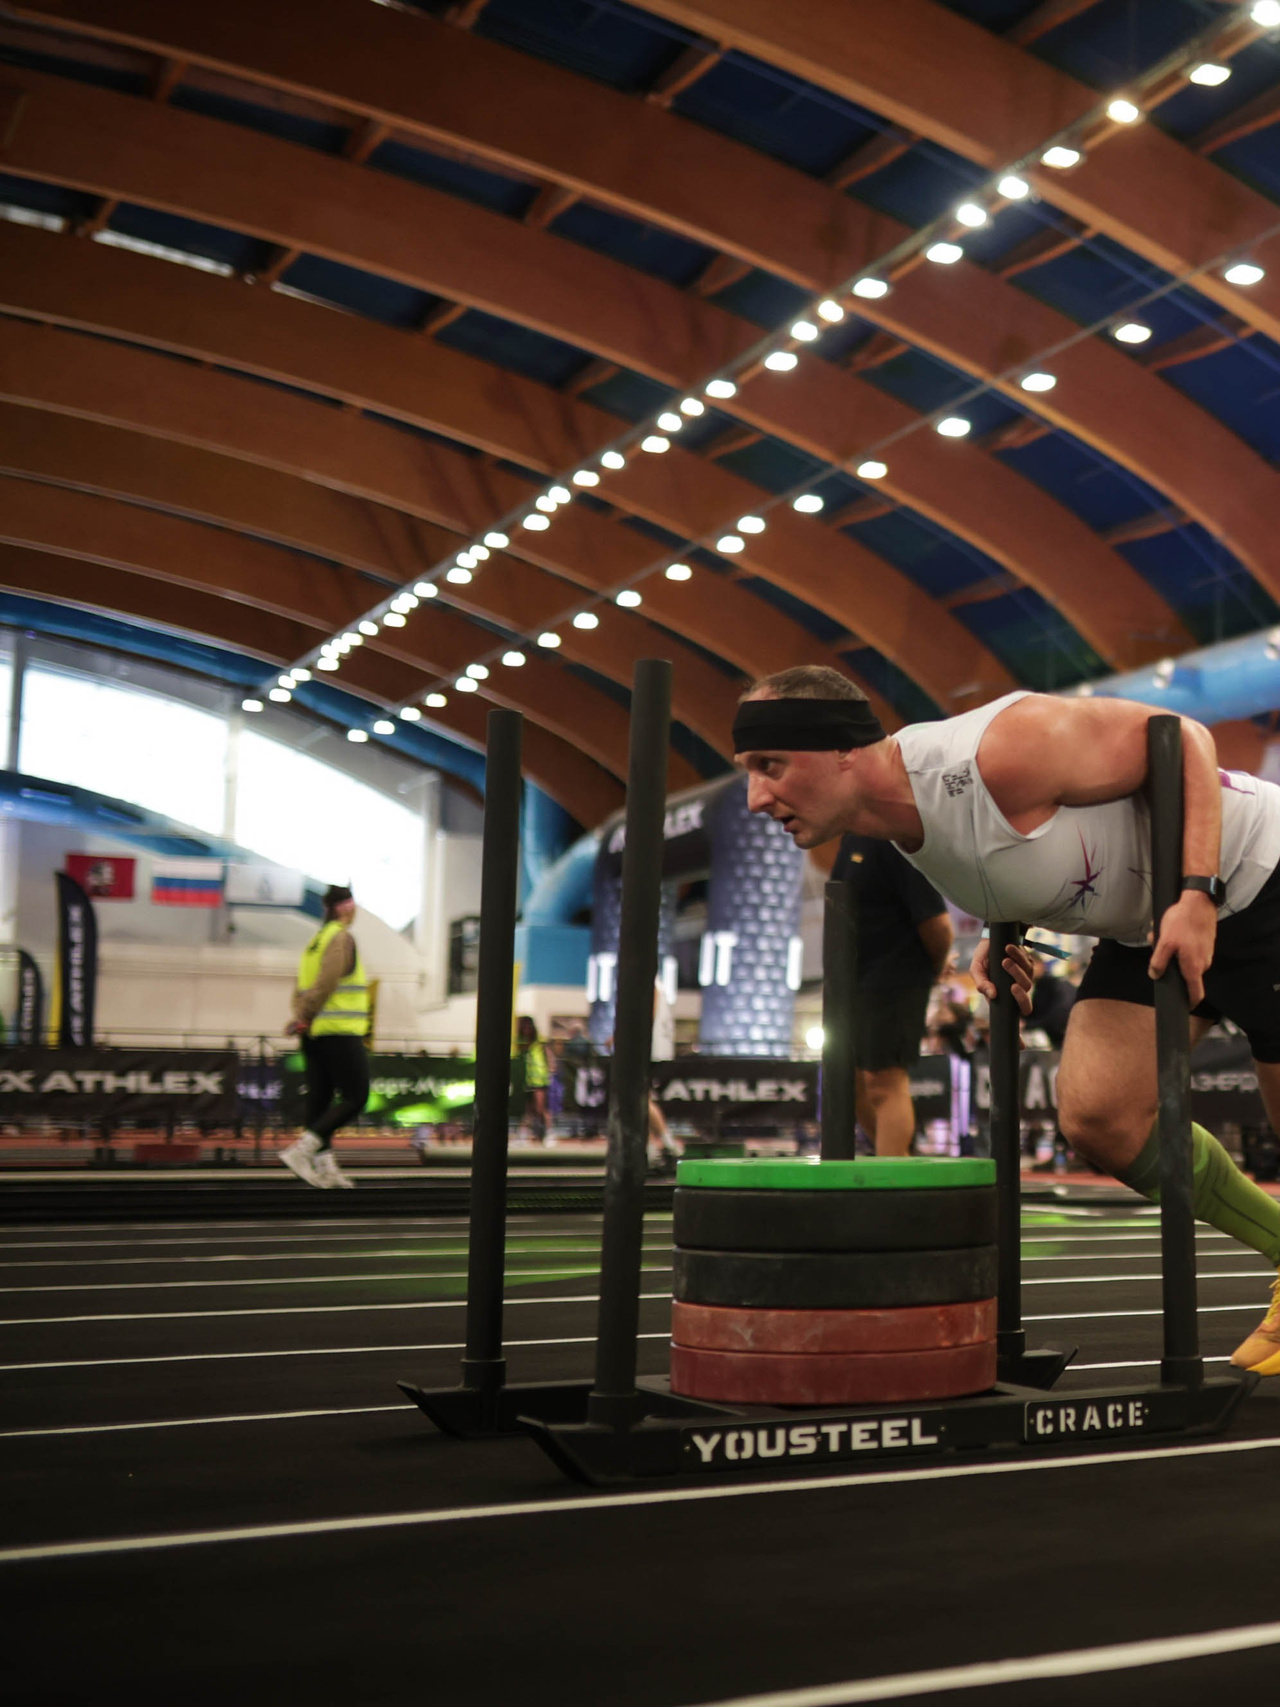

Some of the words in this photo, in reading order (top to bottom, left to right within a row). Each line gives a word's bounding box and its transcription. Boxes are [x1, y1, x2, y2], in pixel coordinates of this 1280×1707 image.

[41, 1070, 224, 1095] ATHLEX
[662, 1079, 808, 1102] ATHLEX
[1036, 1401, 1145, 1436] CRACE
[692, 1417, 938, 1464] YOUSTEEL
